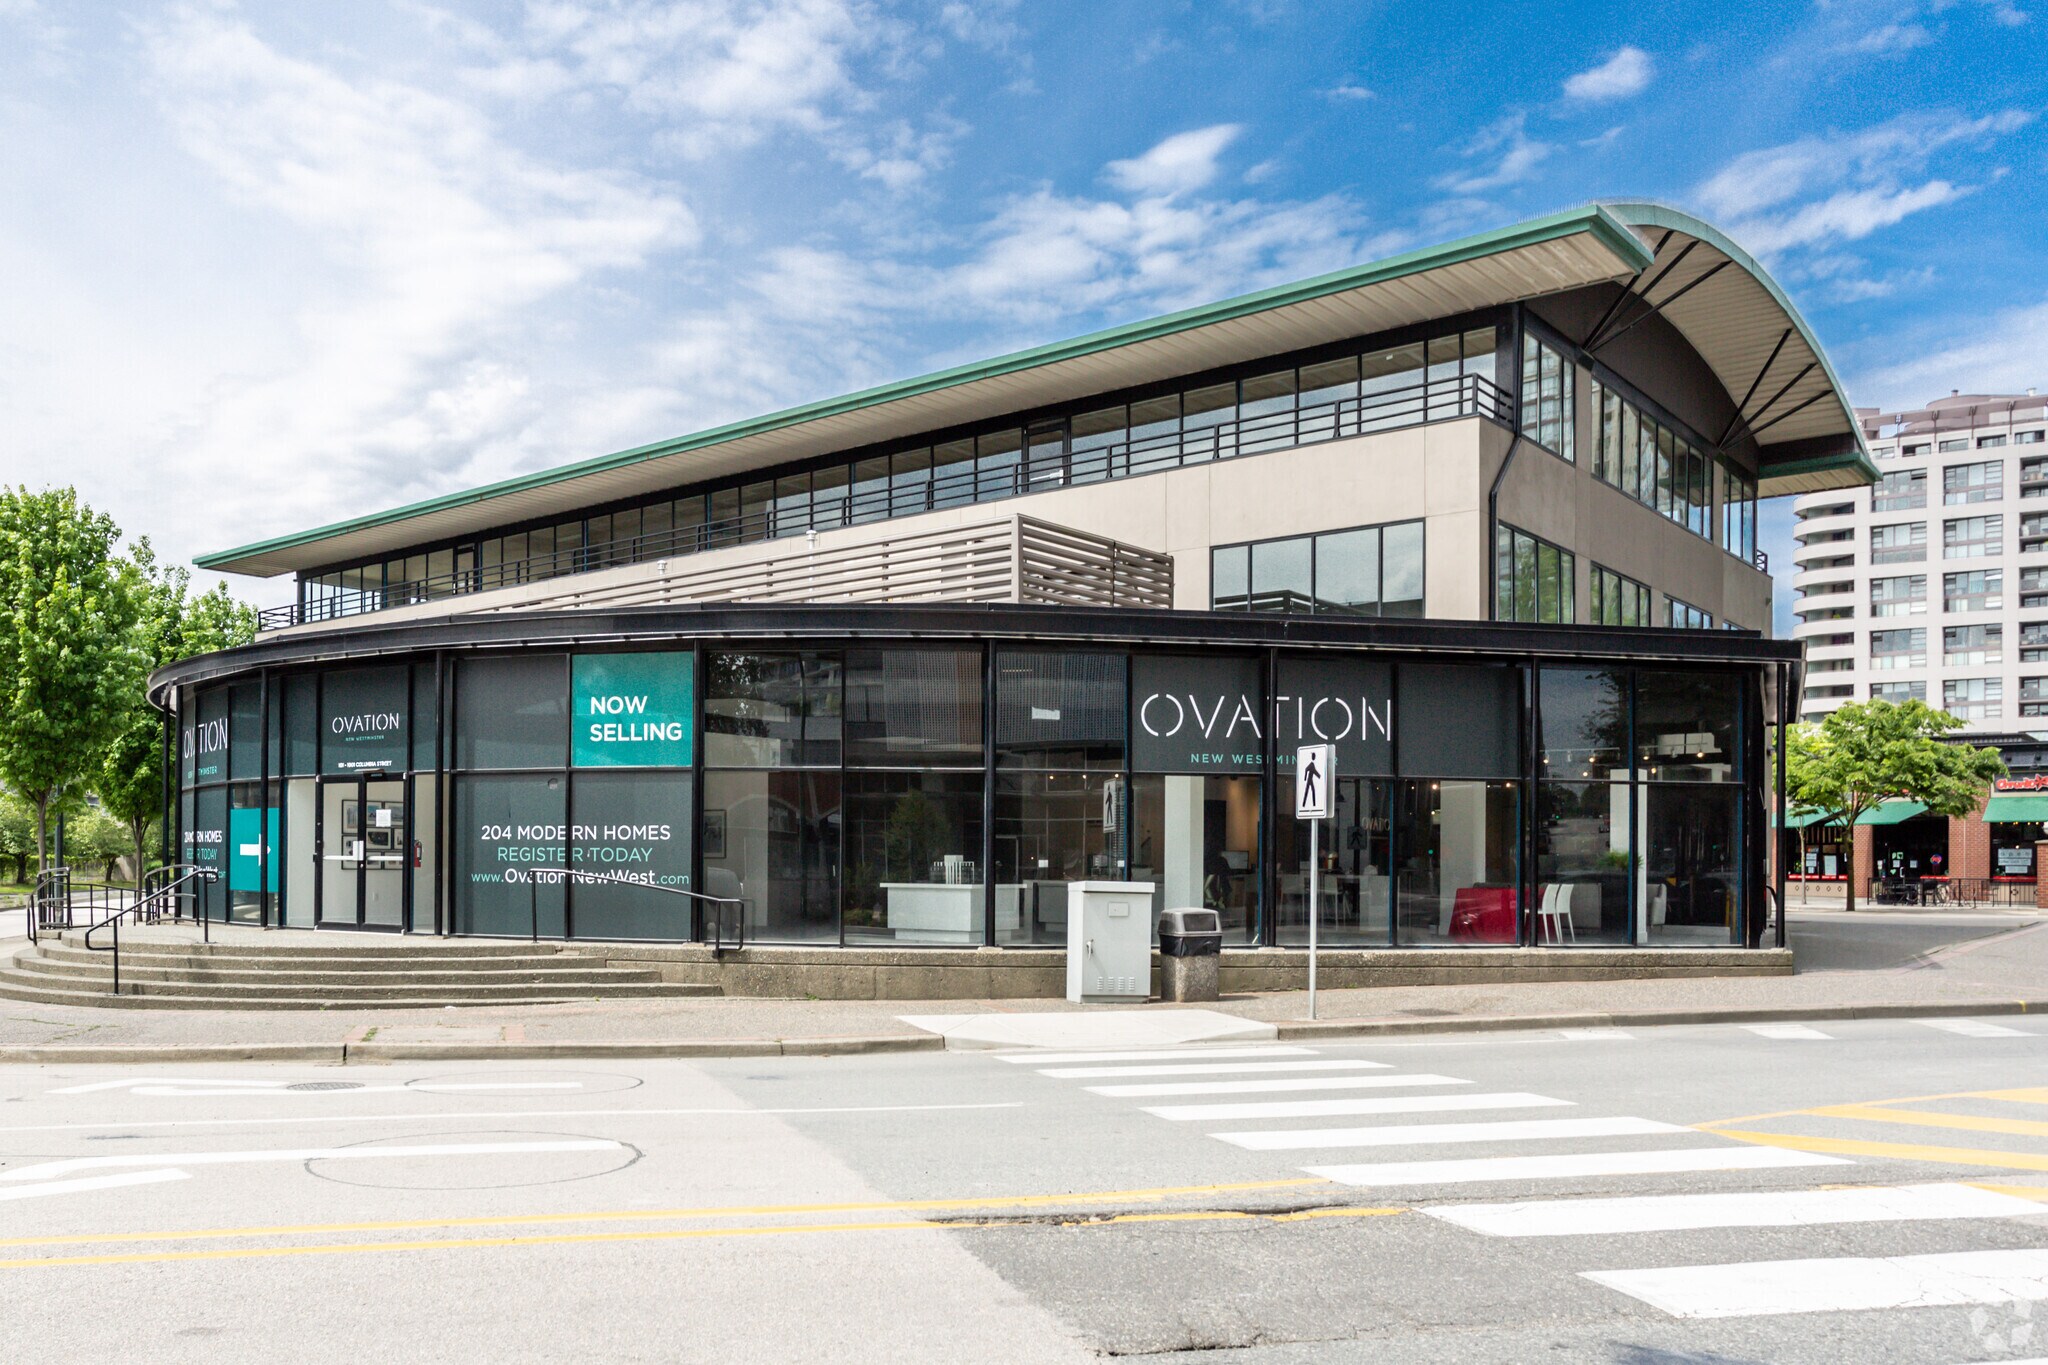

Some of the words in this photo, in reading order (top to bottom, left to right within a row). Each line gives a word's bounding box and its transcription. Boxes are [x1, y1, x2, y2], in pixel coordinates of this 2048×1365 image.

[590, 695, 648, 715] NOW
[332, 712, 399, 733] OVATION
[1140, 693, 1391, 741] OVATION
[184, 718, 228, 759] OVTION
[589, 722, 683, 742] SELLING
[1190, 753, 1223, 764] NEW
[204, 830, 223, 843] HOMES
[481, 825, 512, 840] 204
[517, 825, 597, 840] MODERN
[604, 825, 671, 840] HOMES
[201, 848, 218, 860] TODAY
[497, 847, 583, 861] REGISTER
[589, 847, 653, 862] TODAY
